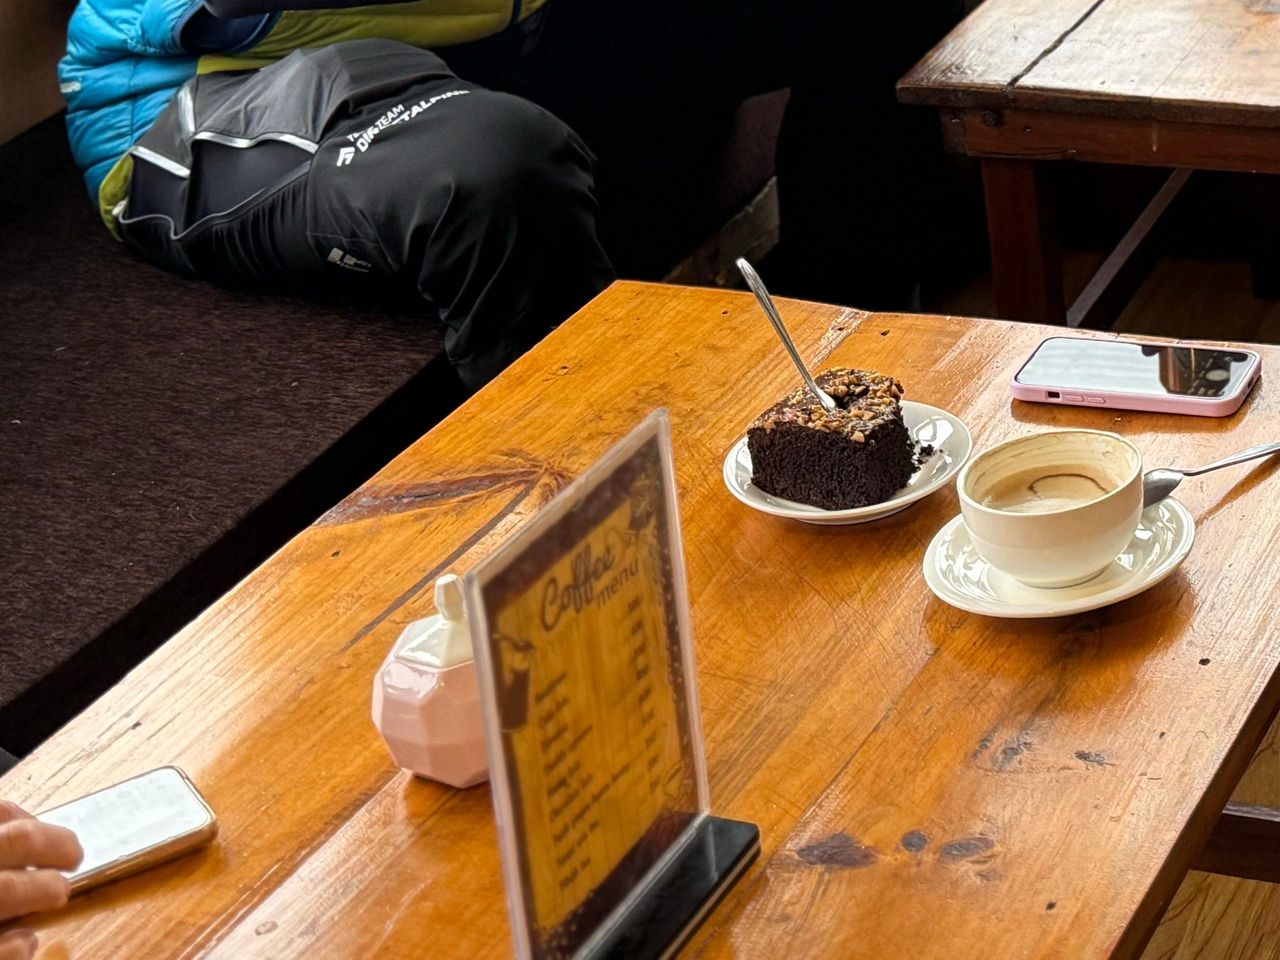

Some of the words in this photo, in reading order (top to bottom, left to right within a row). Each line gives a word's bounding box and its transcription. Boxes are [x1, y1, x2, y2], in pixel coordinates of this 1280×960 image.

[375, 104, 404, 127] TEAM
[541, 543, 616, 633] Coffee
[597, 557, 639, 609] menu
